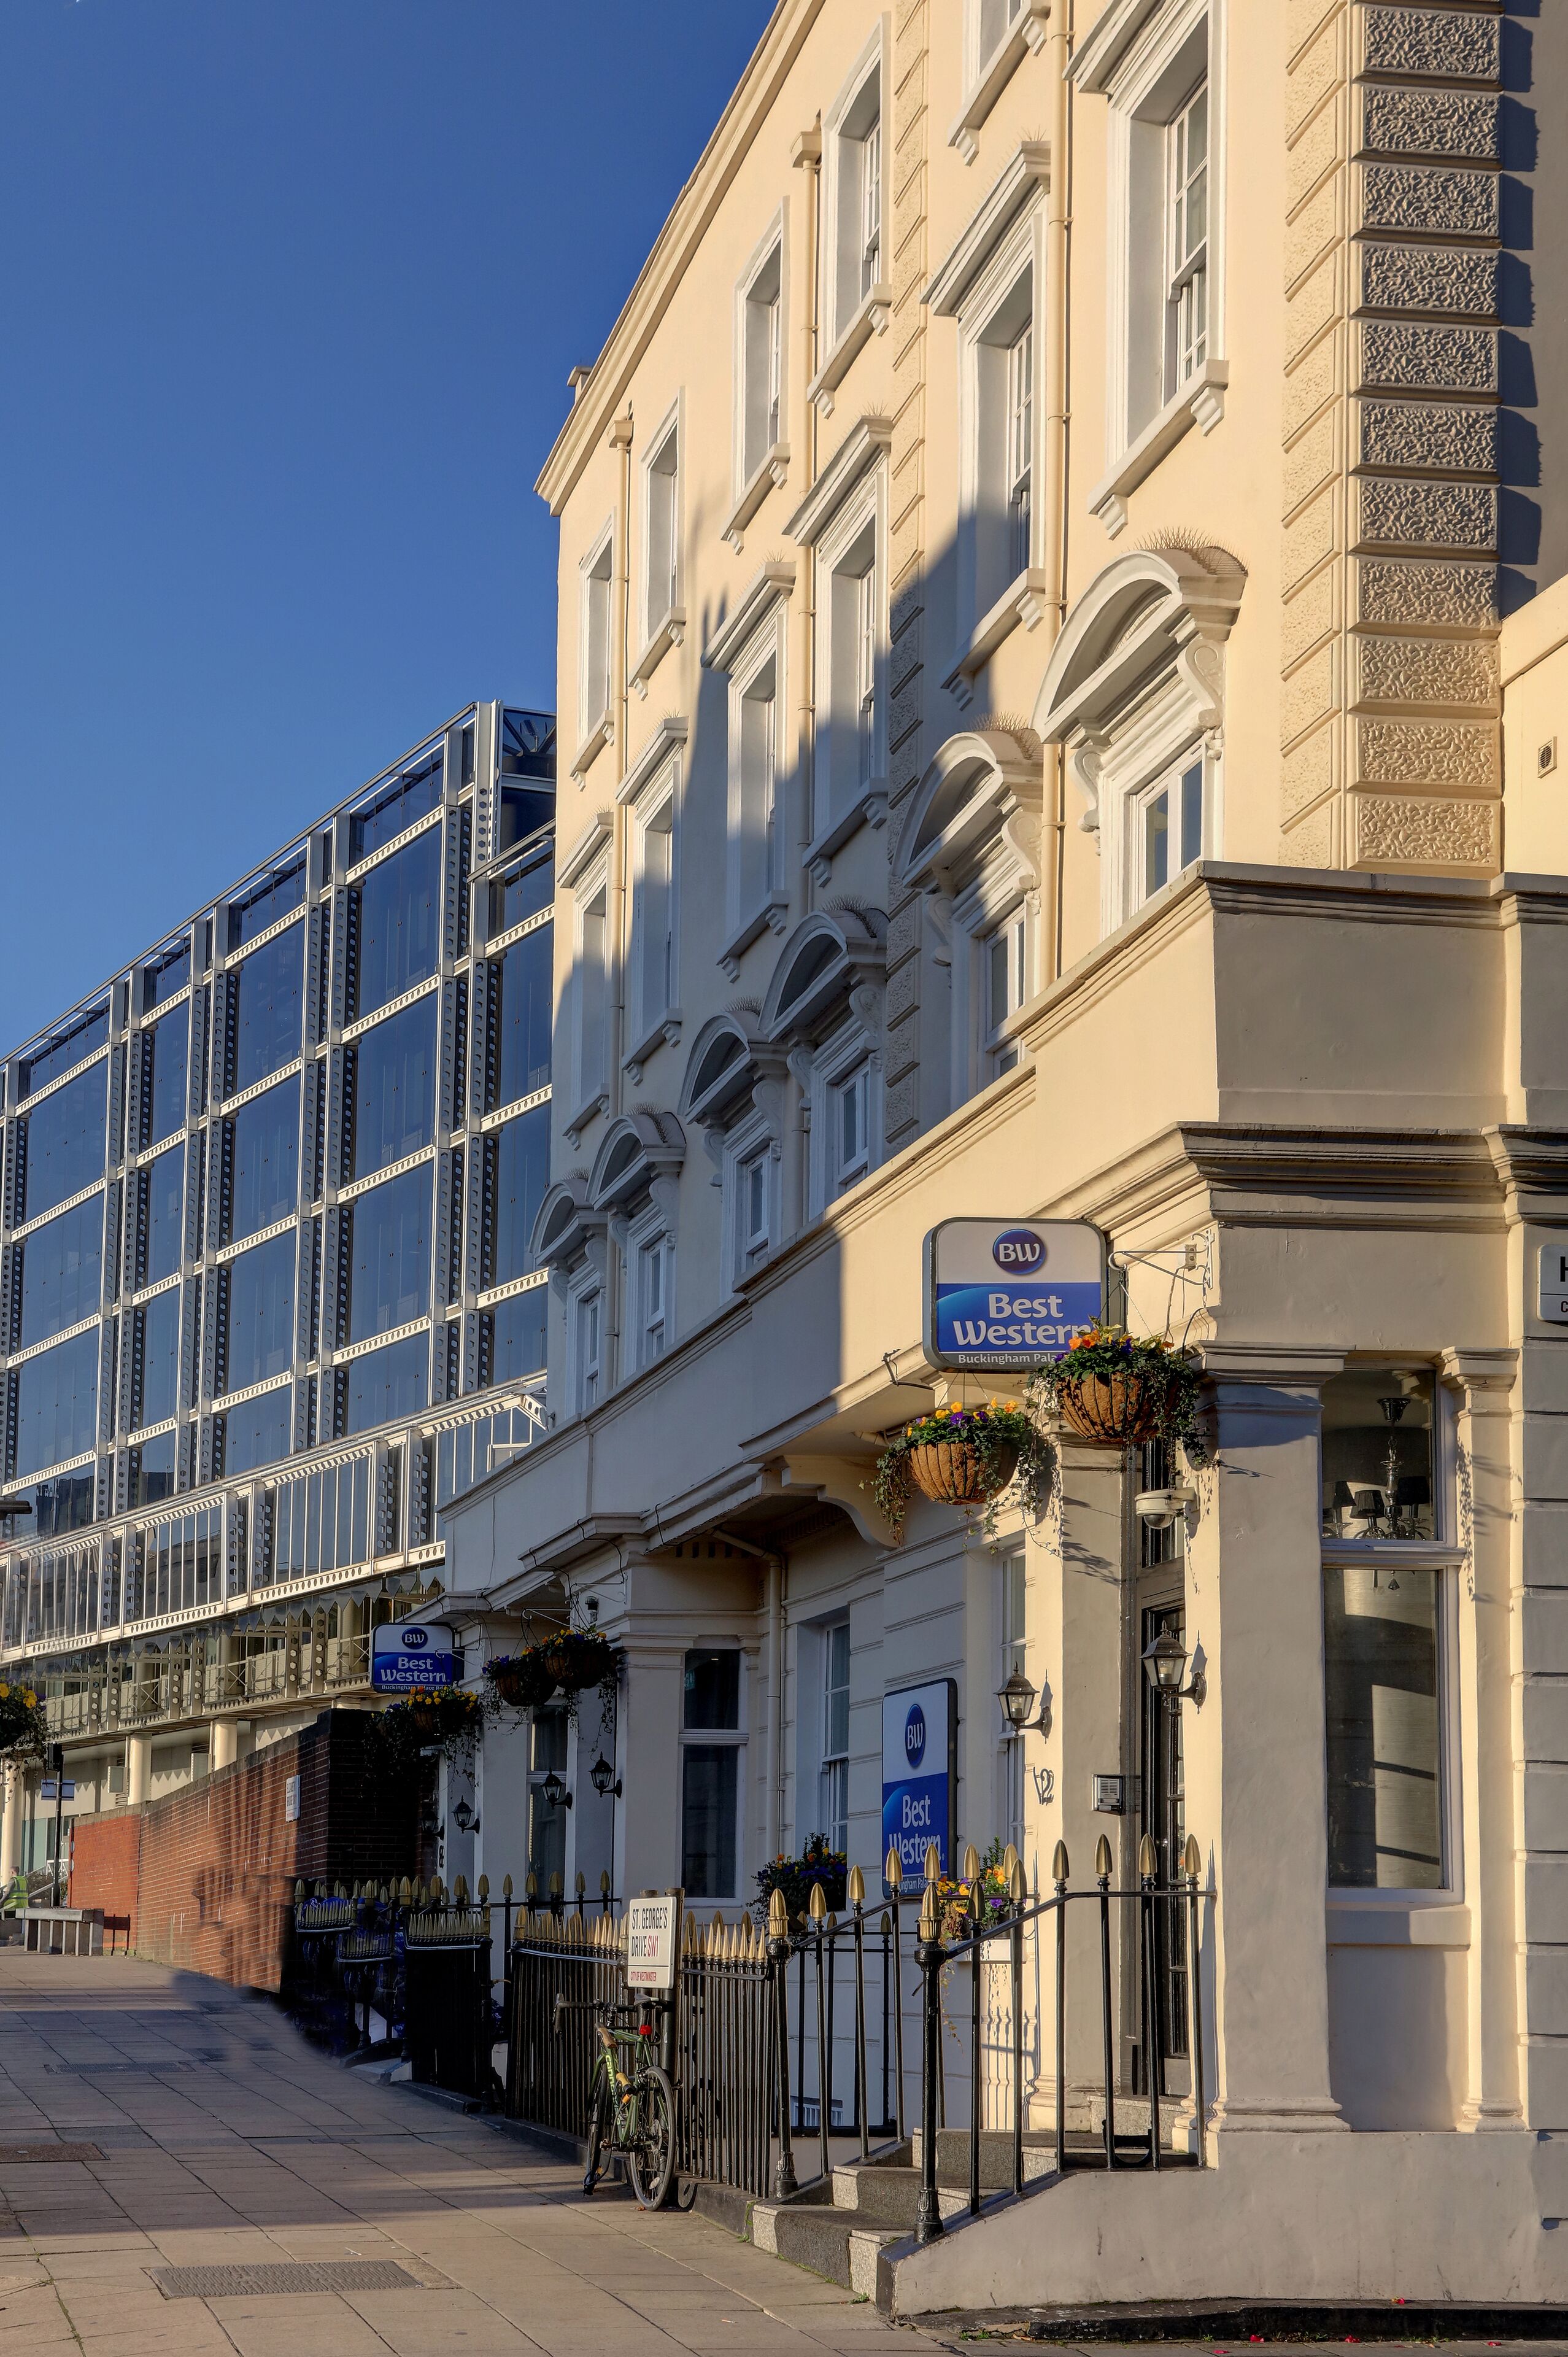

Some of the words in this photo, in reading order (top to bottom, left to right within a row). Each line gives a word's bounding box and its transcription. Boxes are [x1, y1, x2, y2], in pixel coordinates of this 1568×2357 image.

[998, 1243, 1040, 1263] BW
[988, 1293, 1064, 1319] Best
[952, 1320, 1092, 1346] Western
[958, 1353, 1031, 1365] Buckingham
[1033, 1352, 1057, 1363] Pala
[404, 1633, 425, 1644] BW
[380, 1669, 446, 1682] Western
[398, 1657, 433, 1670] Best
[907, 1721, 923, 1751] BW
[902, 1794, 931, 1829] Best
[439, 1844, 444, 1868] 8
[889, 1832, 941, 1865] Western
[631, 1908, 641, 1930] ST.
[642, 1906, 668, 1930] GEORGE'S
[631, 1935, 647, 1957] DRIVE
[647, 1935, 658, 1957] SW1
